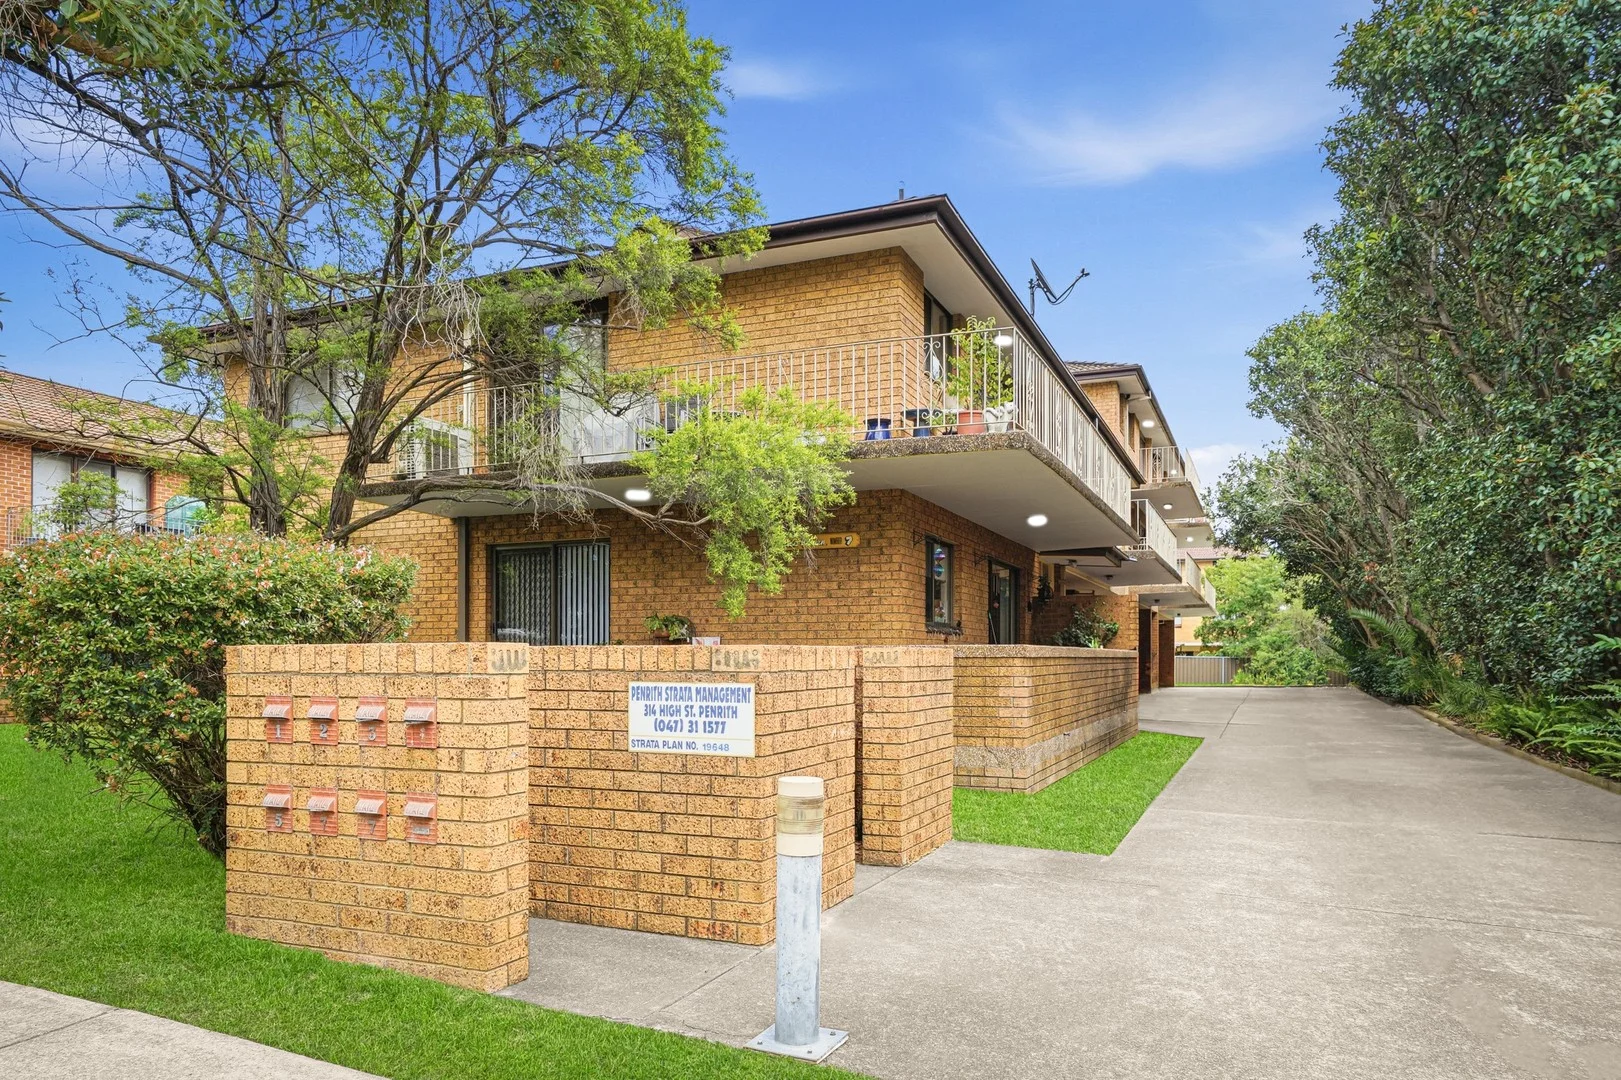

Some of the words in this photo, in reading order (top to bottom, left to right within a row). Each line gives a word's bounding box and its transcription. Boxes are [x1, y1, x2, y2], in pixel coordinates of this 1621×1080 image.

[631, 685, 662, 701] PENRITH
[665, 686, 693, 702] STRATA
[695, 686, 752, 703] MANAGEMENT
[643, 704, 657, 717] 314
[659, 704, 682, 717] HIGH
[684, 704, 696, 718] ST.
[699, 705, 738, 719] PENRITH
[275, 724, 282, 738] 1
[319, 723, 328, 738] 2
[368, 725, 377, 740] 3
[654, 718, 684, 733] (047)
[688, 720, 698, 734] 31
[703, 721, 727, 734] 1577
[631, 738, 659, 749] STRATA
[662, 740, 682, 750] PLAN
[685, 741, 699, 751] NO.
[703, 743, 730, 752] 19648
[275, 813, 282, 827] 5
